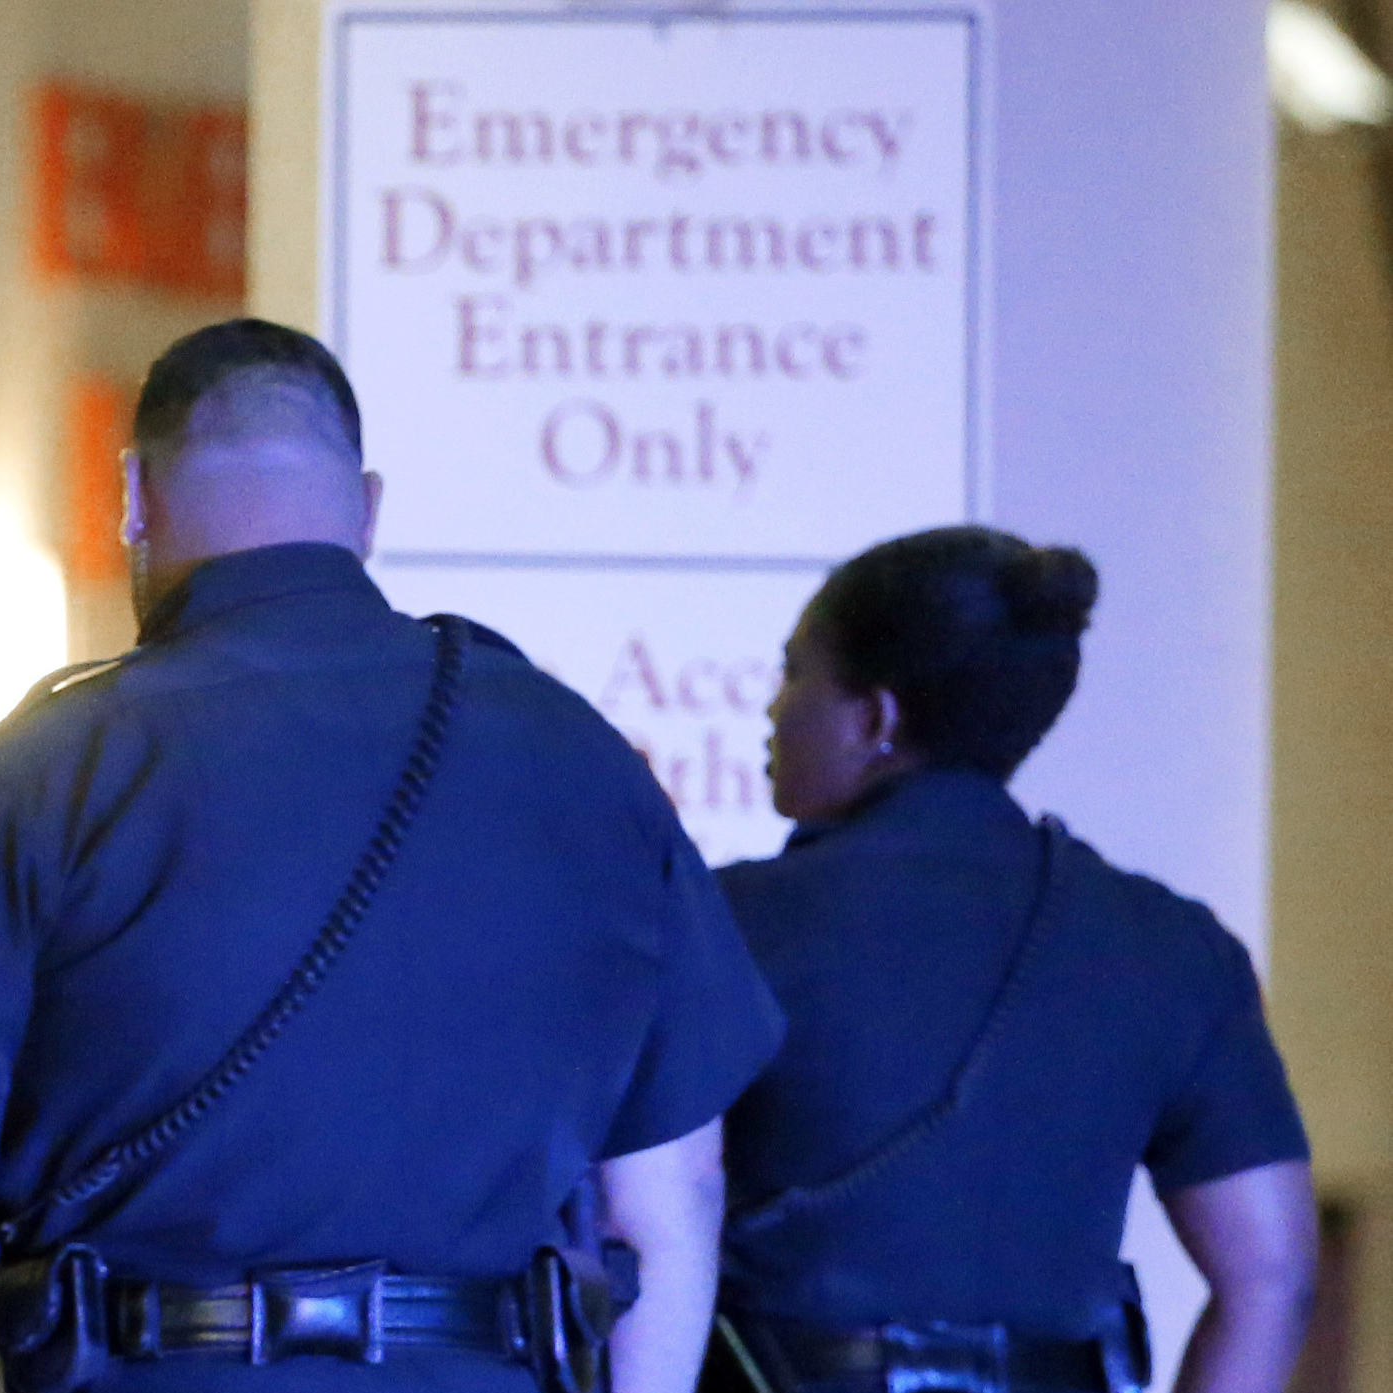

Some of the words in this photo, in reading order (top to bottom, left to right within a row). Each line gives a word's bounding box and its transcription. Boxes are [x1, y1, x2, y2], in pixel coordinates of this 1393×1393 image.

[407, 78, 919, 186] Emergency
[378, 184, 935, 288] Department
[453, 294, 869, 380] Entrance
[537, 398, 773, 502] Only
[597, 632, 783, 716] Acc
